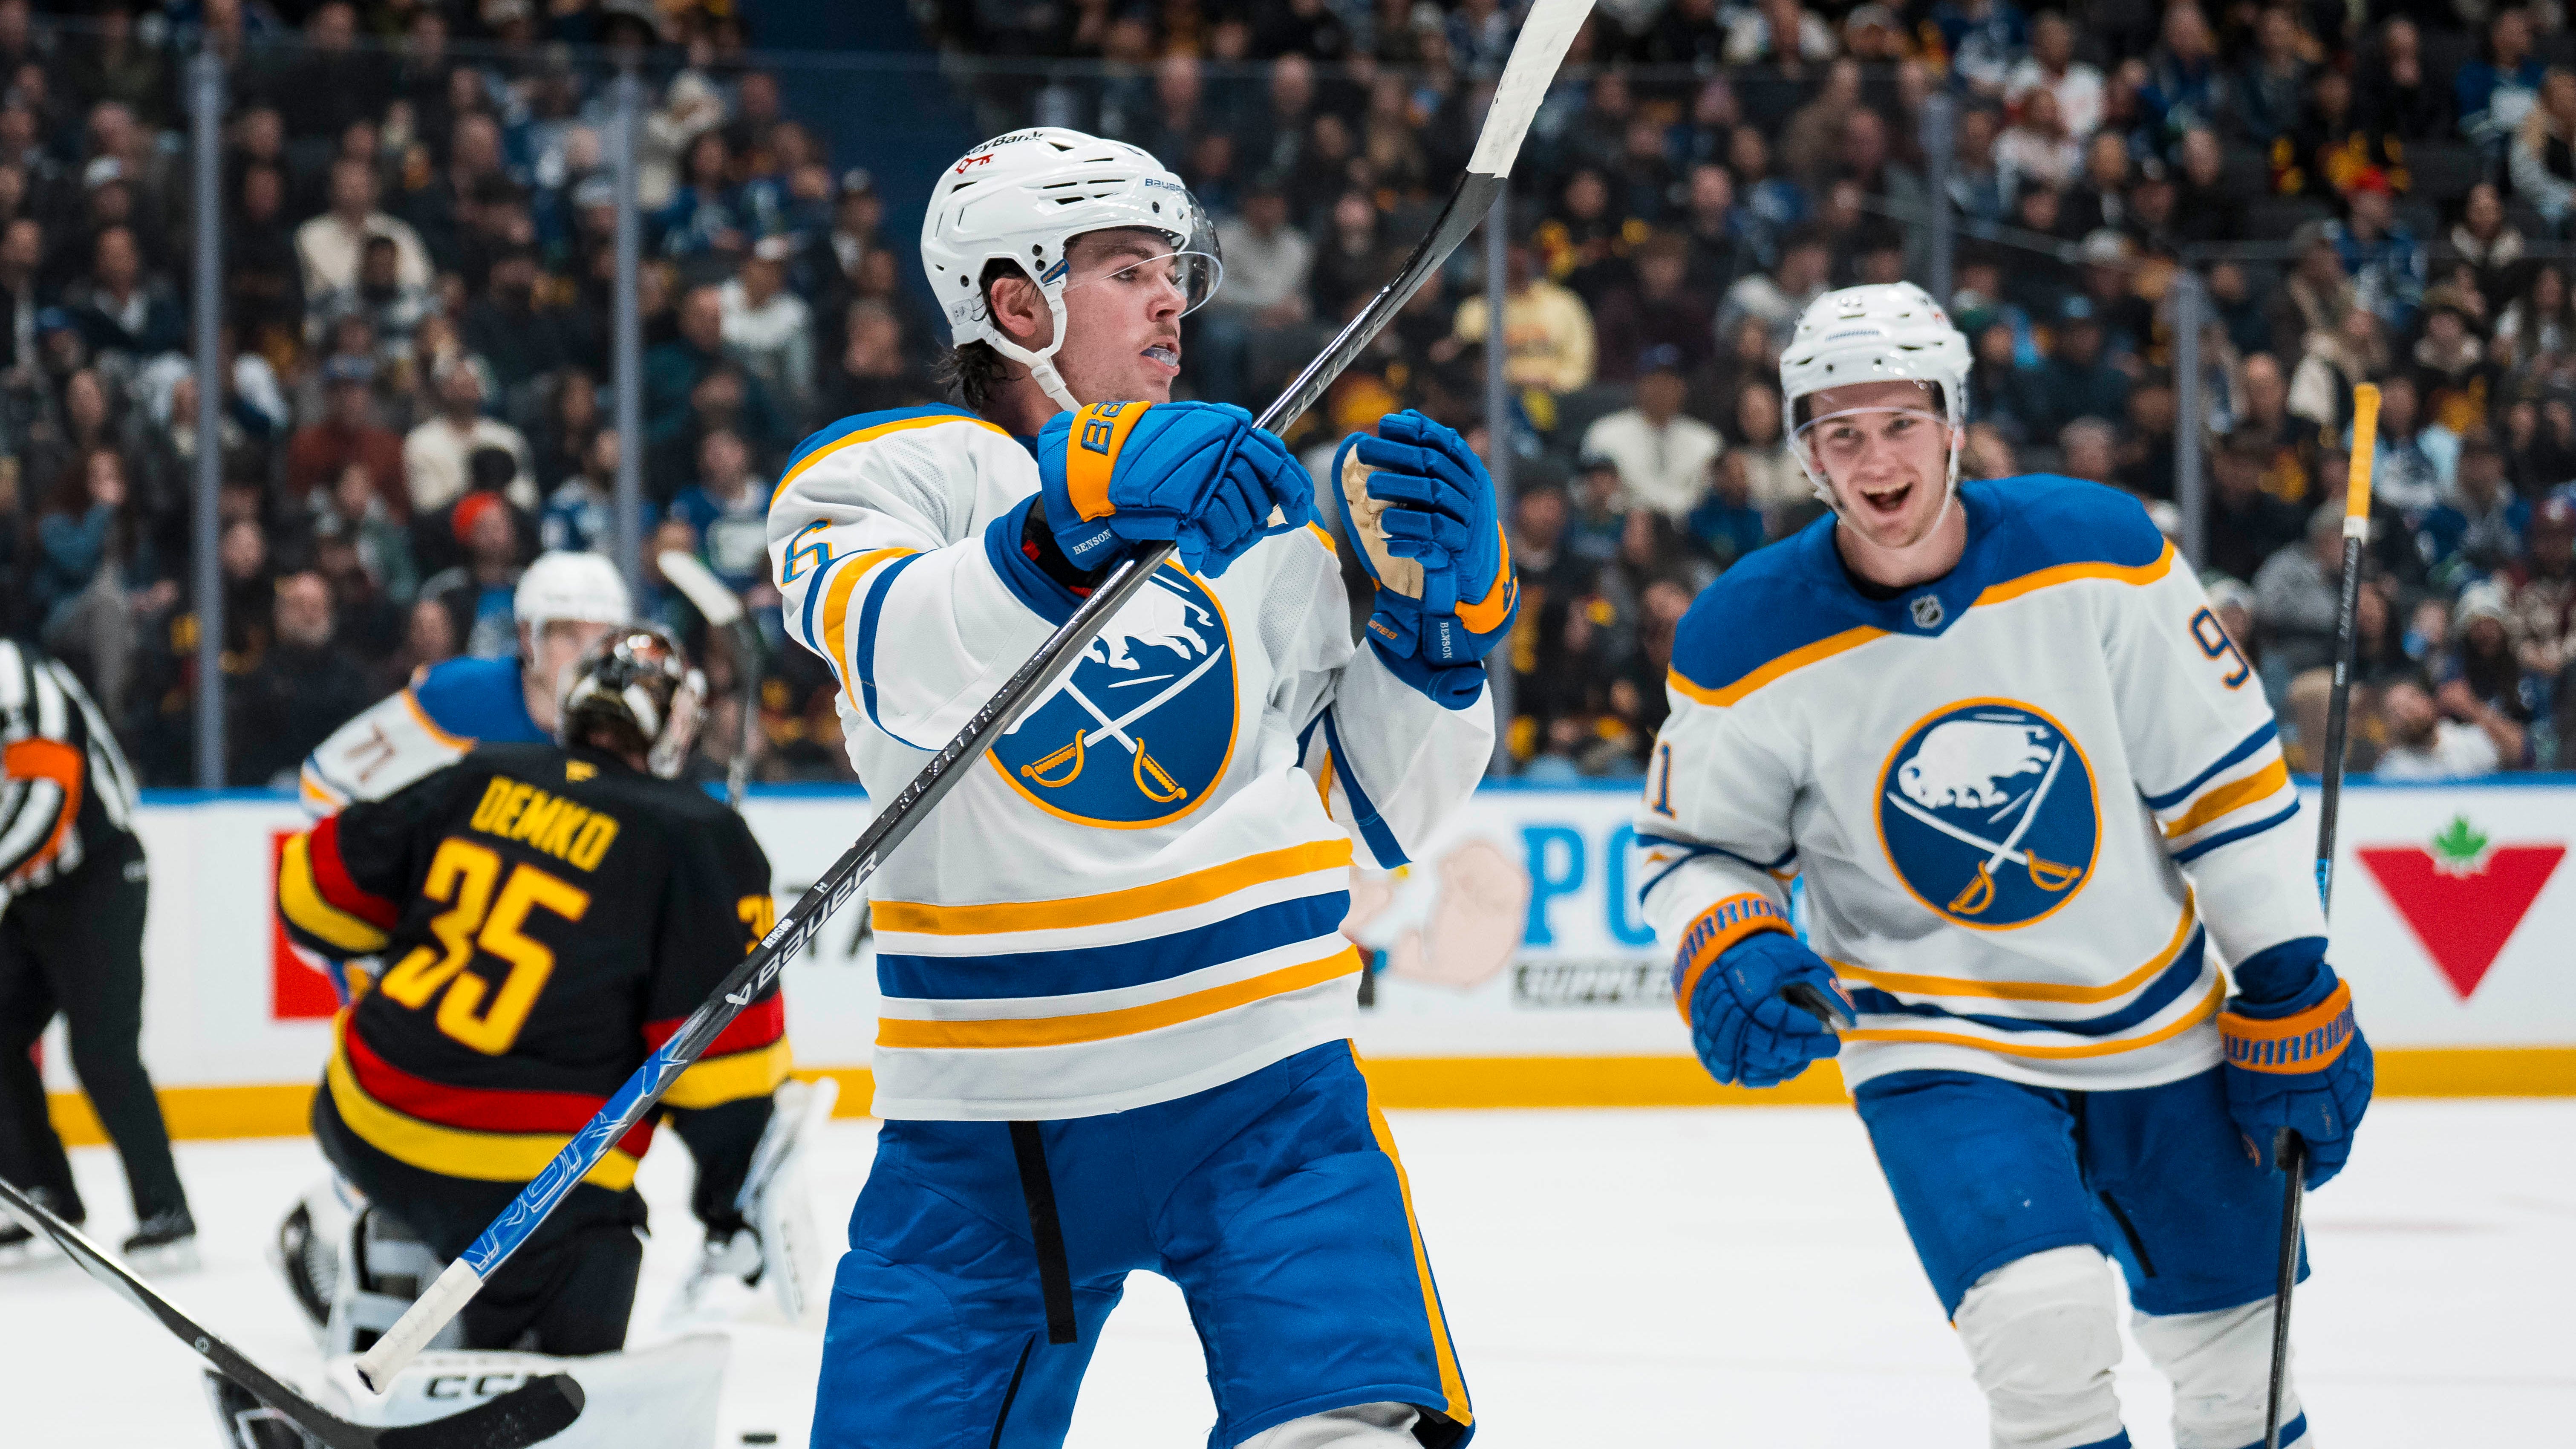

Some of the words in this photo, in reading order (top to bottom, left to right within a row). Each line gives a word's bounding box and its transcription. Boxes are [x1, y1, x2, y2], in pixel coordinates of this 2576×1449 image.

[961, 131, 1044, 159] KeyBank
[1042, 261, 1065, 283] BAUER
[780, 518, 833, 587] 6
[1072, 529, 1112, 555] BENSON
[1440, 621, 1453, 659] BENSON
[470, 776, 620, 873] DEMKO
[380, 835, 593, 1056] 35
[757, 851, 877, 990] BAUER
